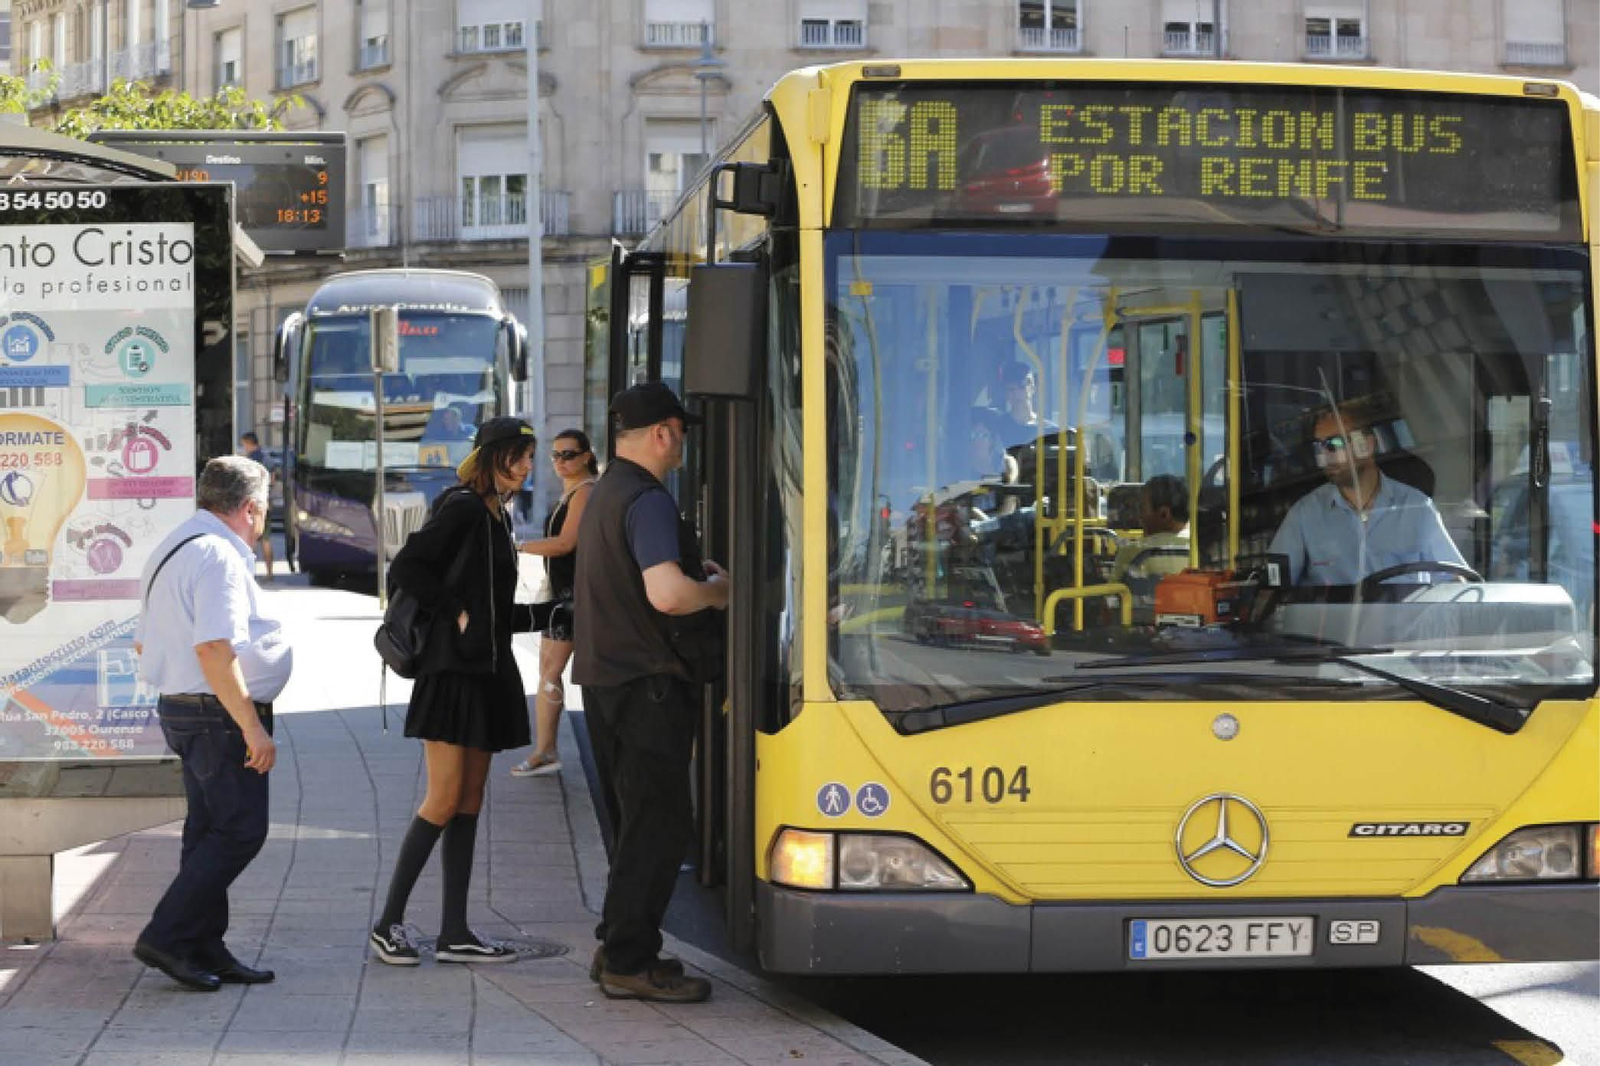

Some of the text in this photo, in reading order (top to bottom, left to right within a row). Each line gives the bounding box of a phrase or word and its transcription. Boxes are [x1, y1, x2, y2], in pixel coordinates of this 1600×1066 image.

[858, 100, 1464, 190] 6A ESTACION BUS
[205, 154, 241, 164] Destino
[317, 171, 328, 184] 9
[1050, 152, 1388, 200] POR RENFE
[12, 193, 41, 210] 54
[44, 191, 73, 209] 50
[77, 191, 106, 209] 50
[300, 190, 328, 204] +15
[276, 209, 321, 223] 18:13
[73, 227, 193, 267] Cristo
[42, 272, 191, 299] profesional
[25, 711, 48, 721] San
[96, 710, 104, 720] 2
[88, 725, 143, 735] Ourense
[930, 765, 1031, 805] 6104
[1353, 823, 1465, 836] CITARO
[1154, 924, 1234, 954] 0623
[1246, 921, 1305, 952] FFY
[1334, 921, 1377, 942] SP
